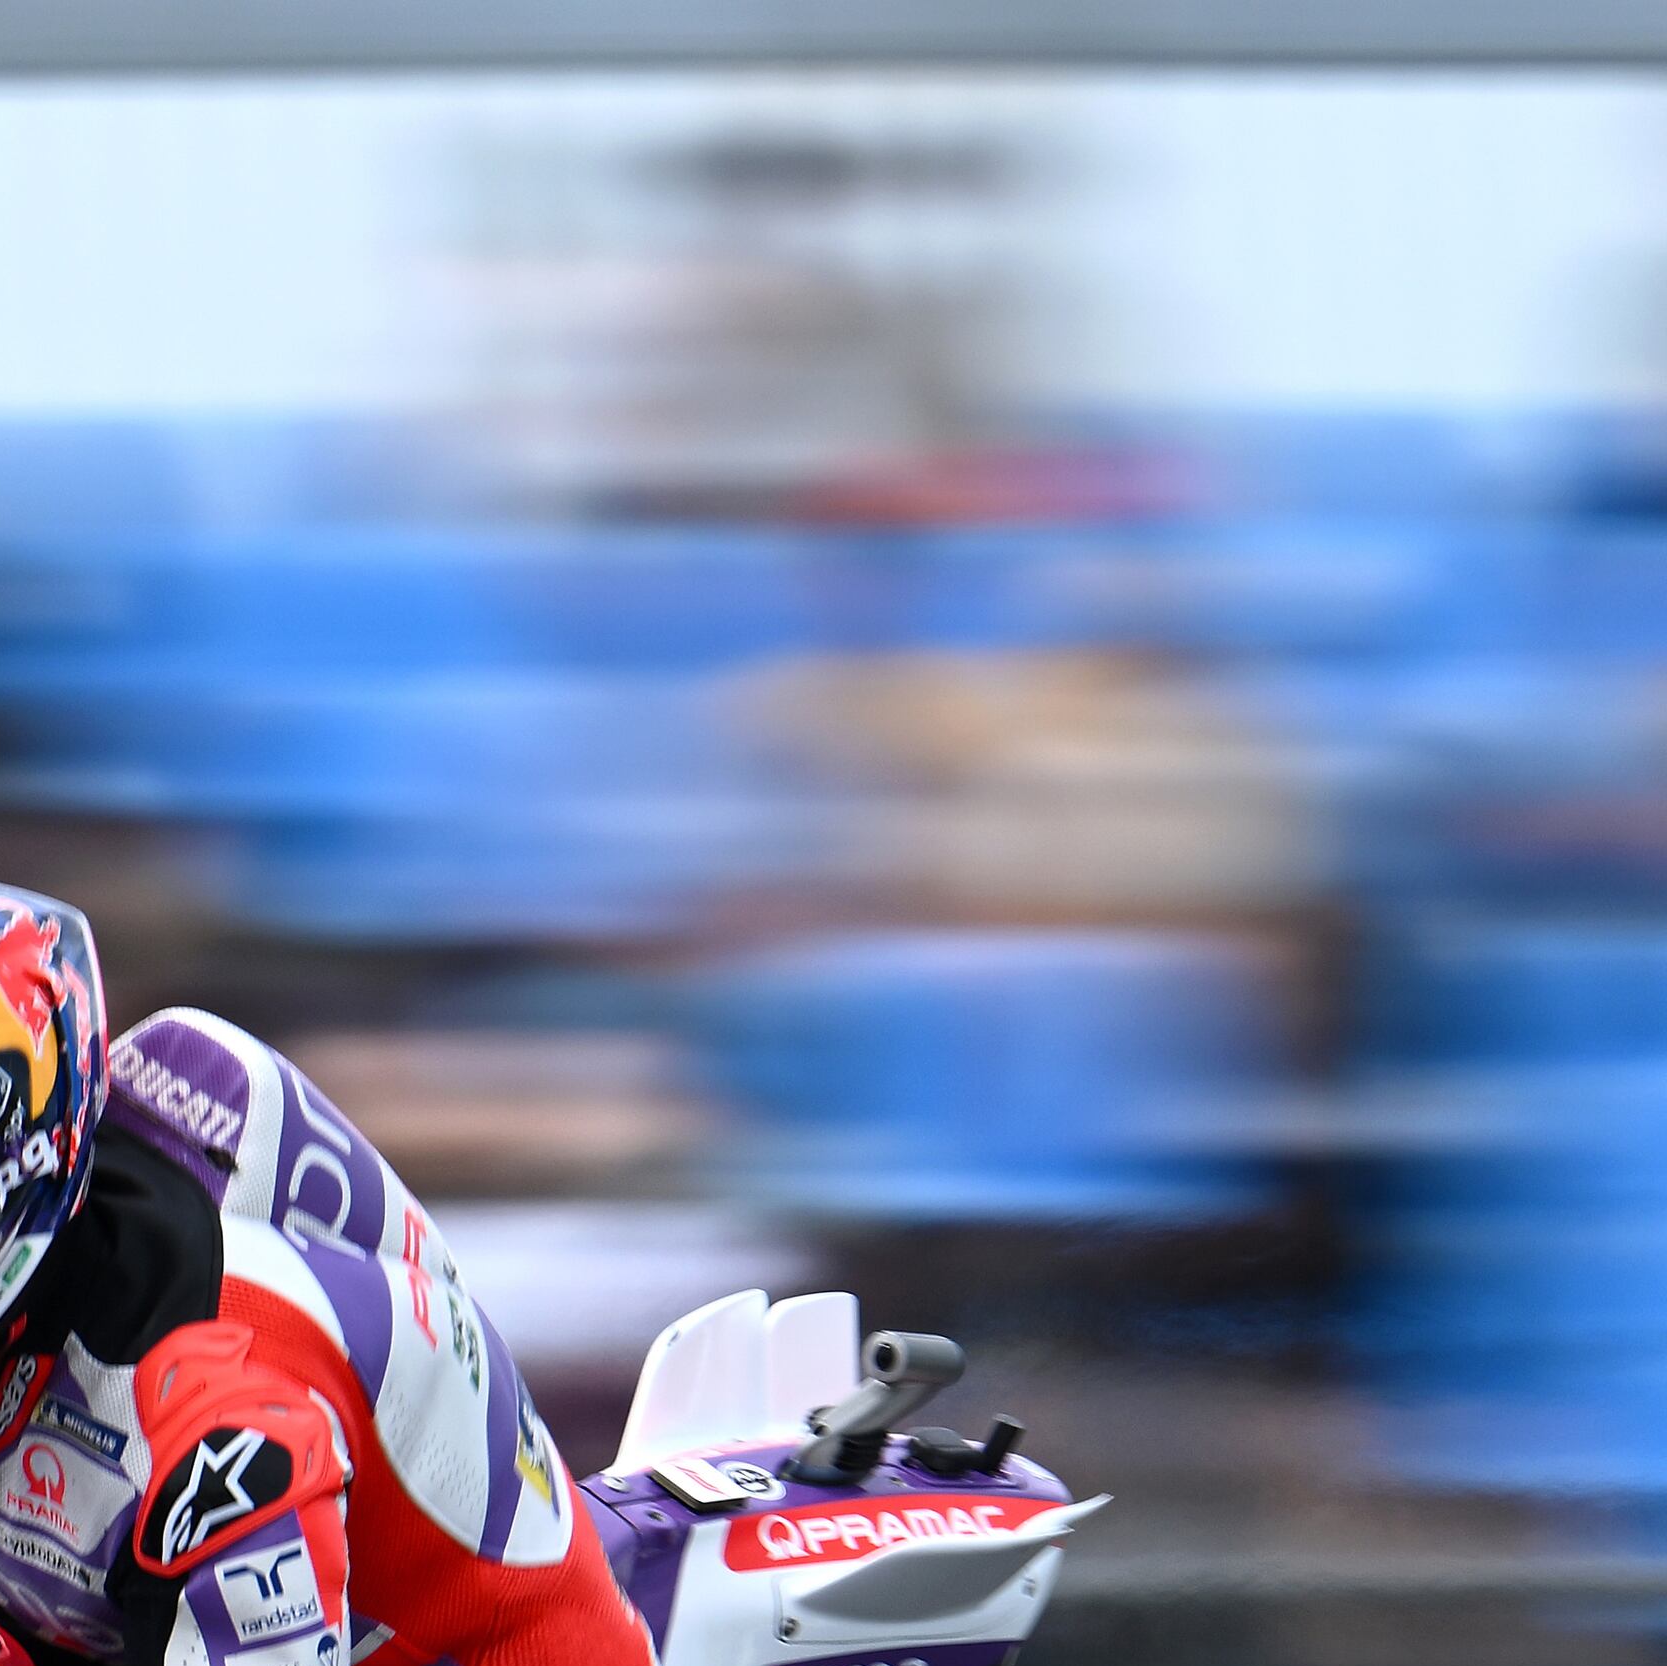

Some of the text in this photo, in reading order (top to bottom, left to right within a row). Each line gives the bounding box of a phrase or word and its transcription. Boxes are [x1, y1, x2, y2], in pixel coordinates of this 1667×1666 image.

[109, 1043, 241, 1146] DUCATI
[798, 1505, 1005, 1555] PRAMAC
[240, 1593, 319, 1639] randstad
